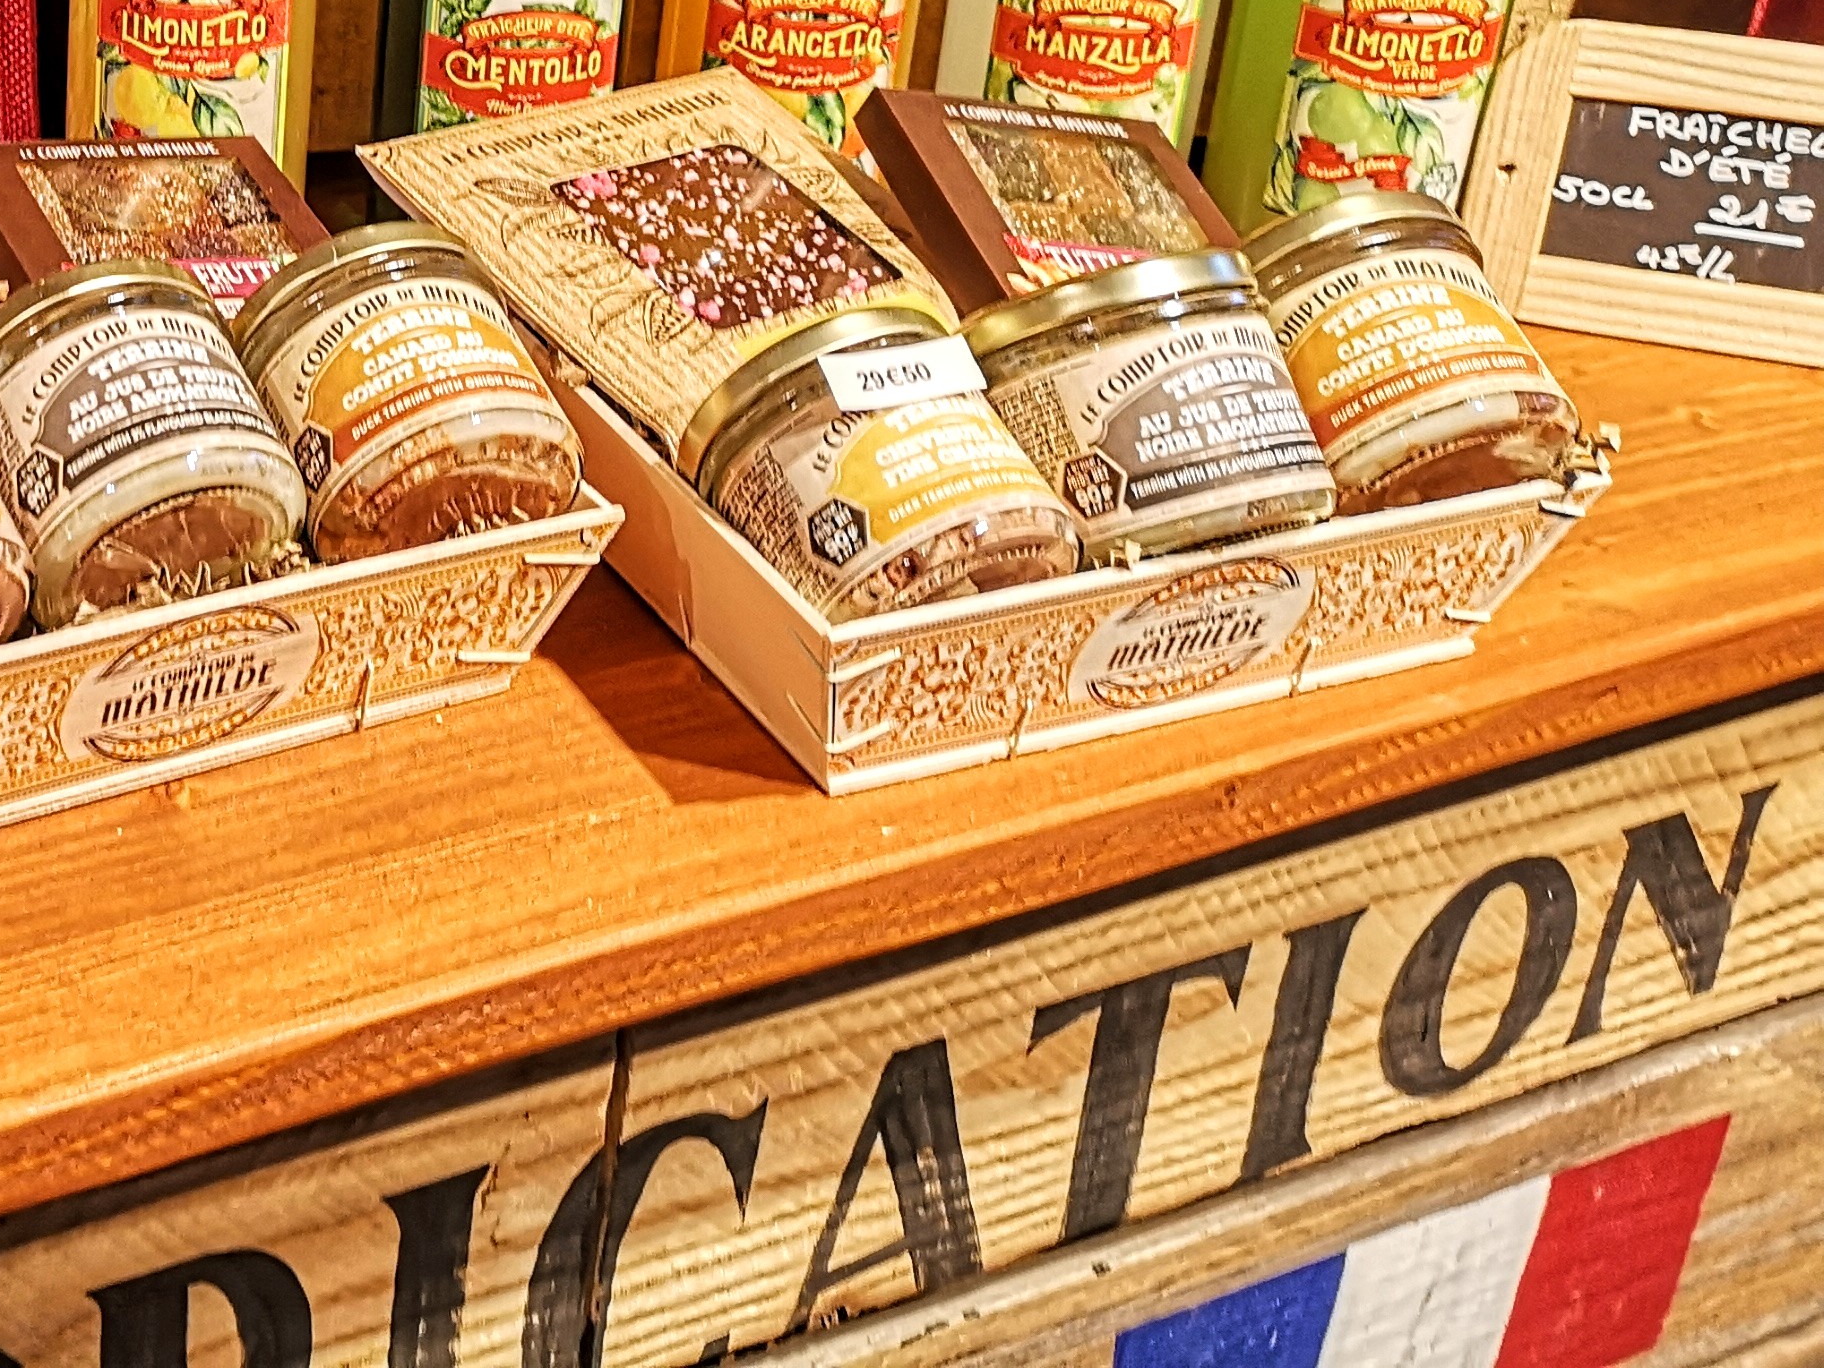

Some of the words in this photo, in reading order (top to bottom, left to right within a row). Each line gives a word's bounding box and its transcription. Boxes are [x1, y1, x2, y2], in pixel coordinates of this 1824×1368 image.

[120, 9, 266, 56] LIMONELLO
[718, 20, 884, 66] ARANCELLO
[1026, 25, 1172, 75] MANZALLA
[1328, 22, 1484, 71] LIMONELLO
[445, 50, 602, 93] MENTOLLO
[37, 144, 118, 161] COMPTOIR
[138, 141, 220, 158] MATHILDE
[1660, 145, 1792, 190] D'ÉTÉ
[351, 303, 471, 354] TERRINE
[1322, 283, 1451, 337] TERRINE
[87, 337, 210, 382] TERRINE
[363, 334, 452, 378] CANARD
[1337, 313, 1432, 362] CANARD
[342, 362, 415, 412] CONFIT
[856, 362, 932, 392] 29€50
[1096, 330, 1205, 402] COMPTOIR
[1161, 357, 1277, 403] TERRINE
[1317, 345, 1395, 397] CONFIT
[351, 417, 381, 442] DUCK
[1138, 410, 1172, 439] AU
[1178, 398, 1222, 427] JUS
[1330, 403, 1362, 428] DUCK
[1134, 428, 1205, 464] NOIRE
[876, 451, 937, 489] FINE
[889, 497, 921, 524] DEER
